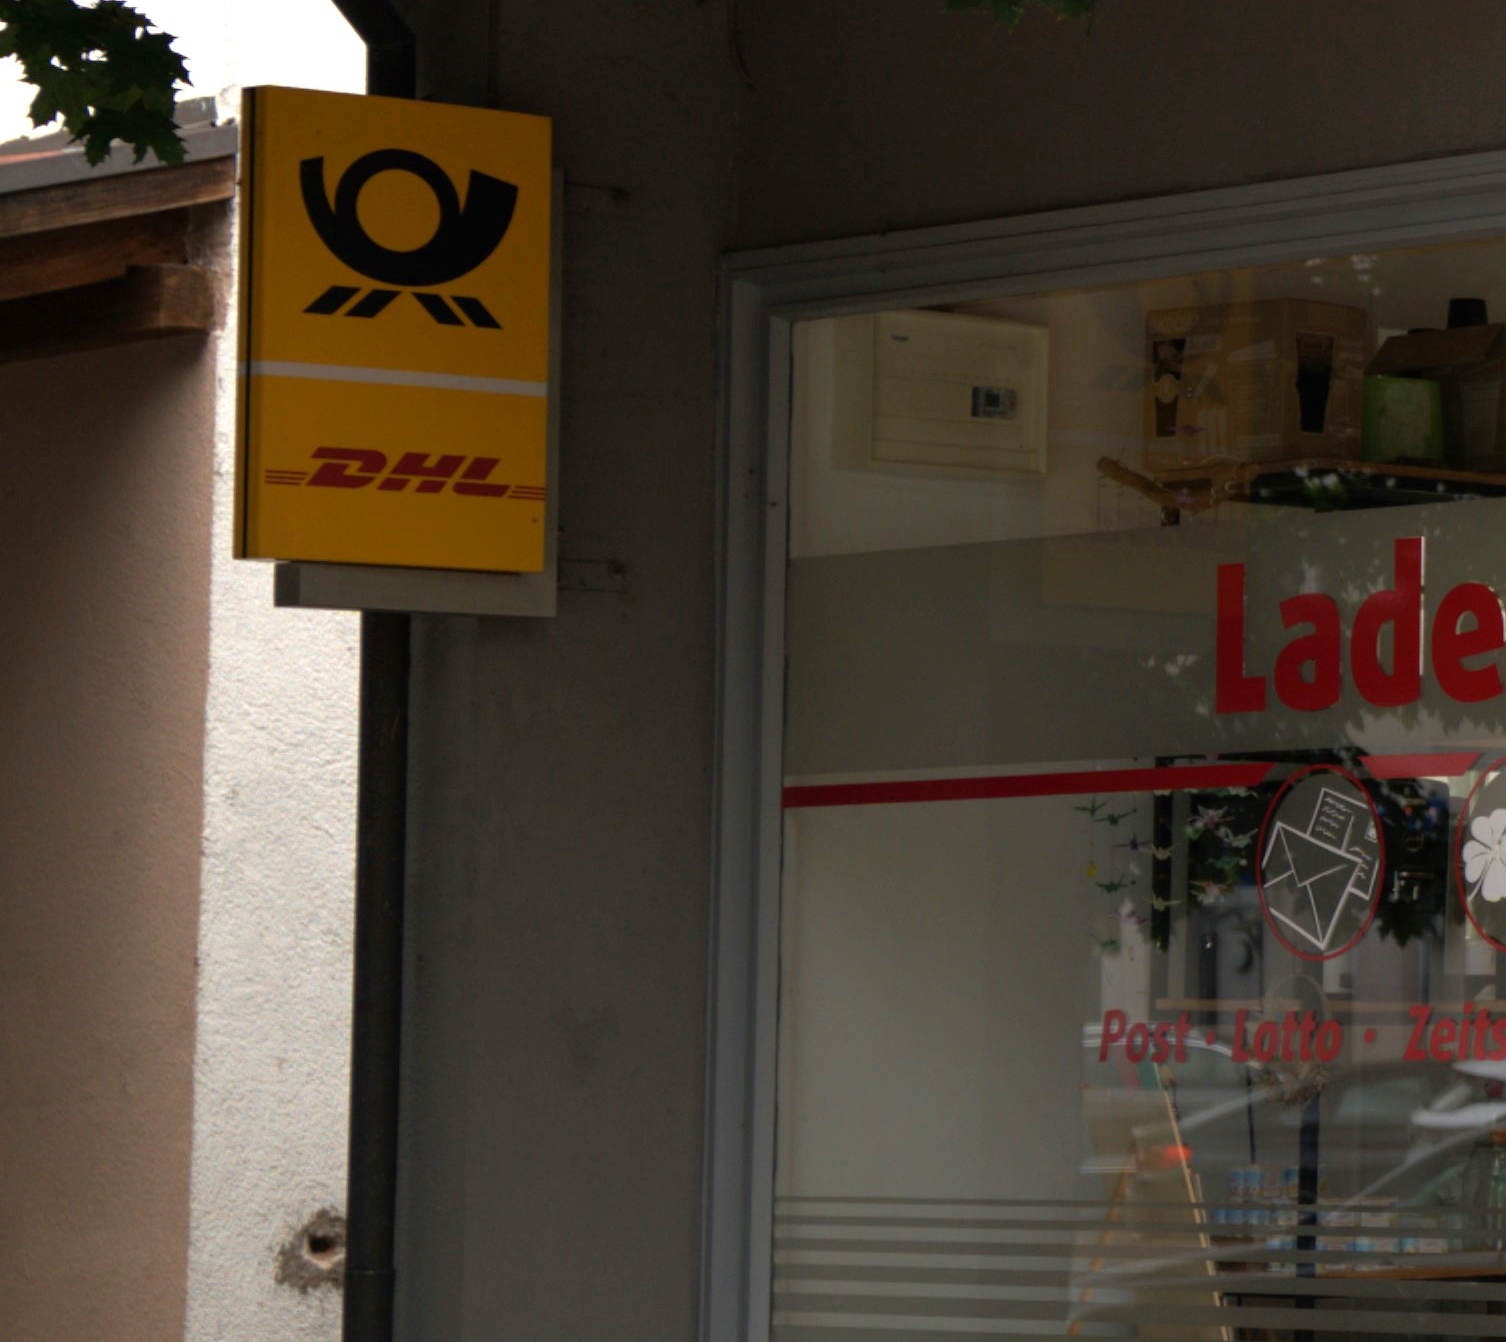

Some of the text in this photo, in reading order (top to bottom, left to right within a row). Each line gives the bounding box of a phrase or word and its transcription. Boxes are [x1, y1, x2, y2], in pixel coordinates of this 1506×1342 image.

[306, 446, 512, 498] DHL
[1101, 1008, 1191, 1063] Post
[1231, 1008, 1343, 1063] Lotto
